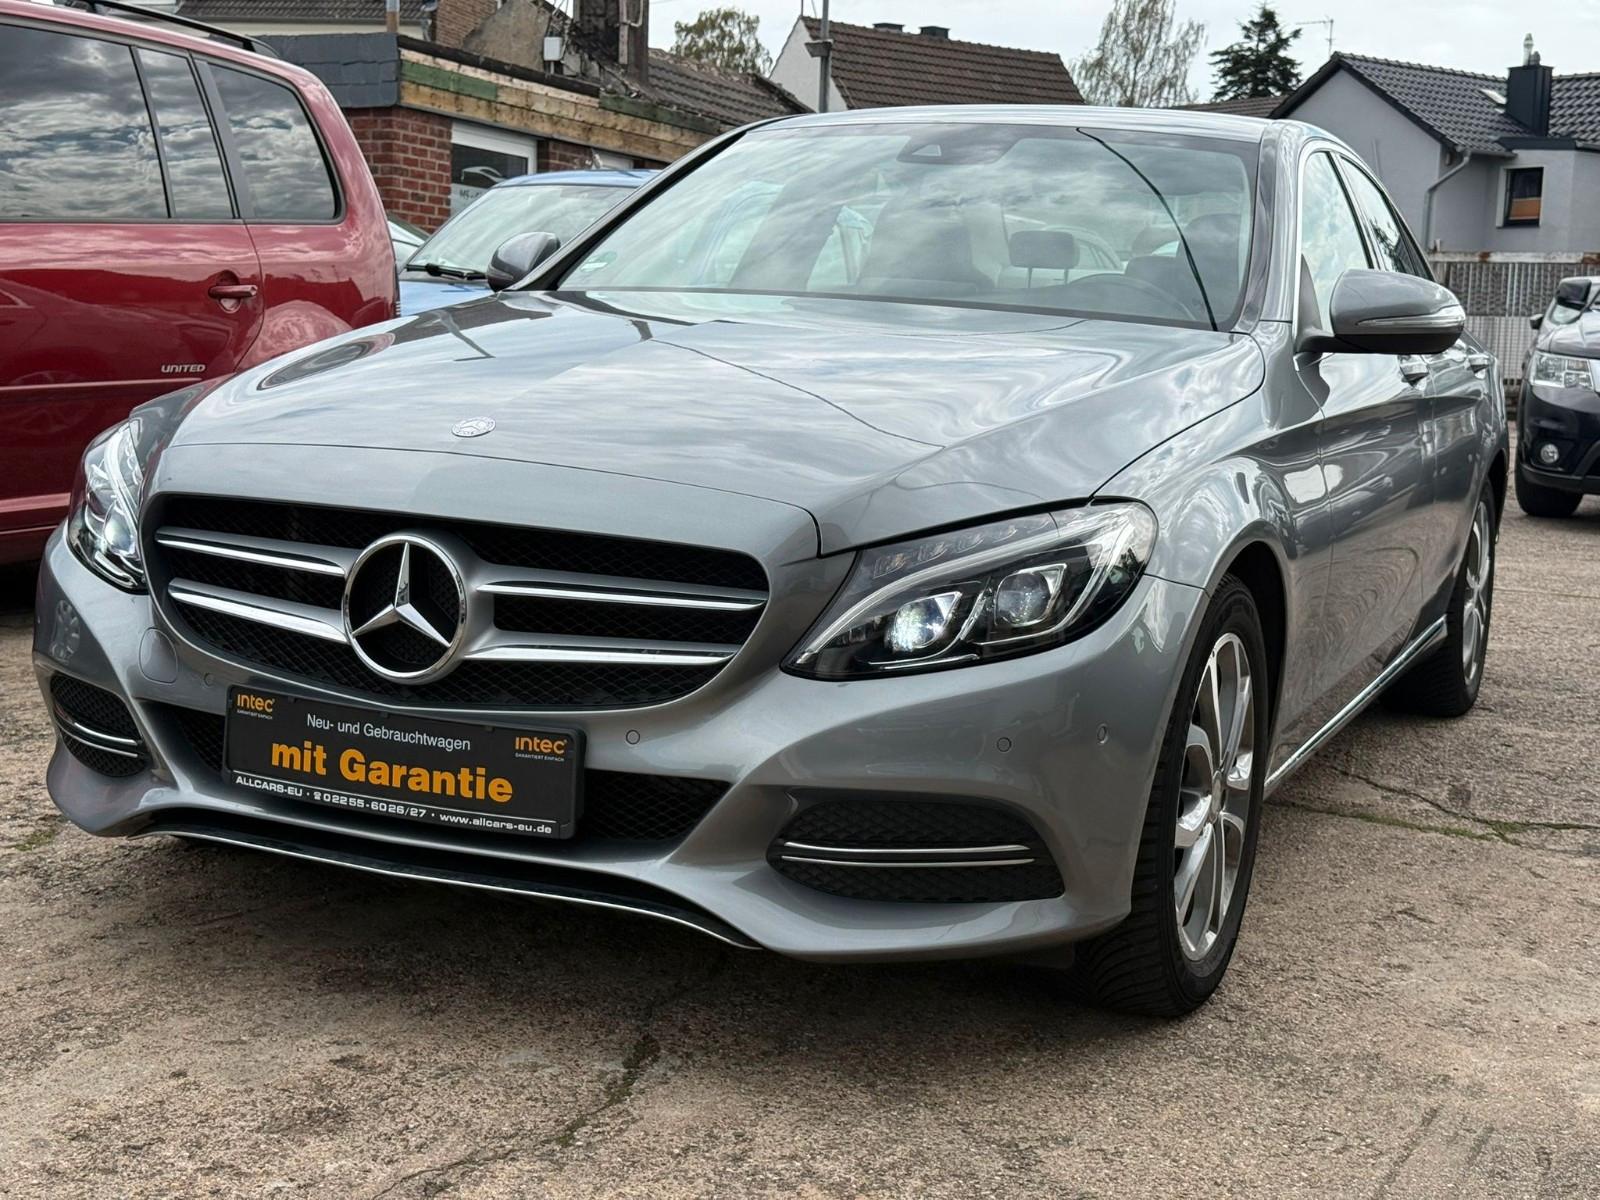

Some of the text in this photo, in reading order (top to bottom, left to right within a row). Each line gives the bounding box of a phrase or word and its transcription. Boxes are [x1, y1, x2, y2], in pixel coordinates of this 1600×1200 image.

[161, 364, 206, 373] UNITED
[307, 713, 471, 751] Neu- und Gebrauchtwagen
[271, 741, 513, 803] mit Garantie
[235, 775, 303, 797] ALLCARS-EU
[439, 813, 552, 834] www.allcars-eu.de
